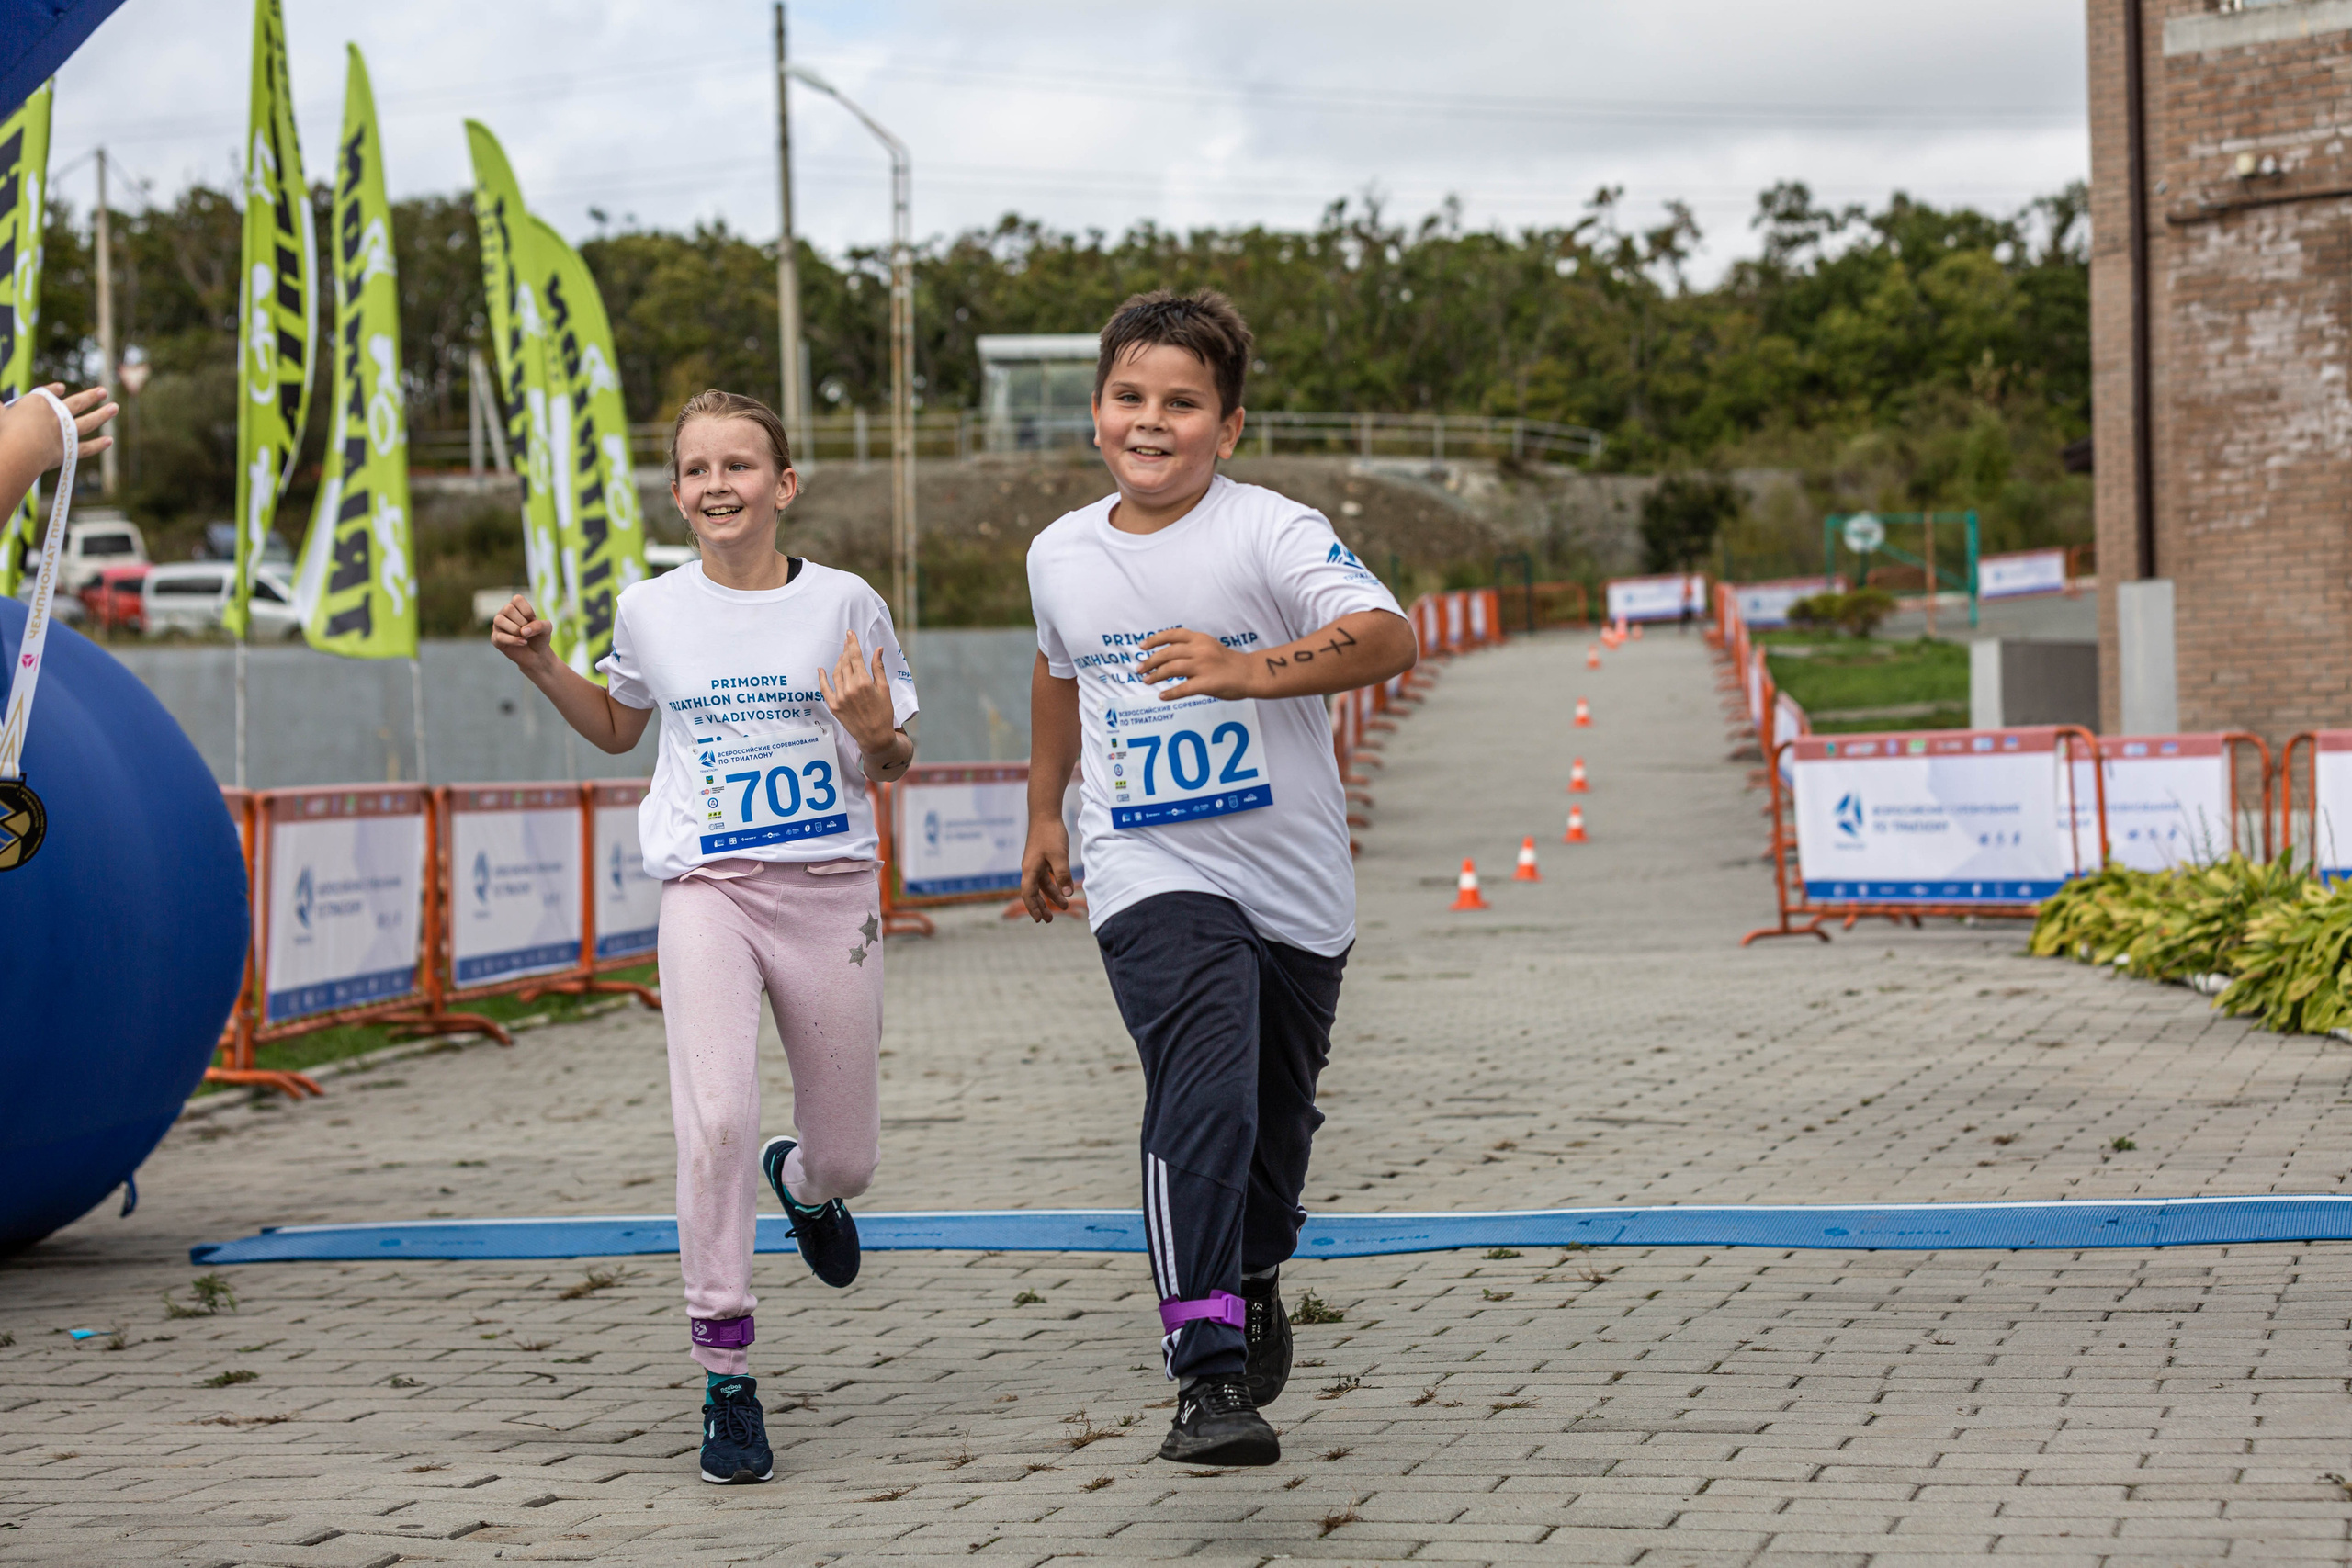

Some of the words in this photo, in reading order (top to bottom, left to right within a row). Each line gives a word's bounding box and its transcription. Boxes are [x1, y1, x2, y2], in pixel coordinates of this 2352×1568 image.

[28, 542, 57, 640] ЧЕМПИОНАТ
[51, 417, 73, 538] ПРИМОРСКОГО
[1102, 624, 1184, 647] PRIMO
[711, 675, 787, 690] PRIMORYE
[669, 694, 731, 712] TRIATHLON
[736, 691, 826, 704] CHAMPIONS
[1118, 705, 1170, 717] ВСЕРОССИЙСКИЕ
[1172, 697, 1224, 710] СОРЕВНОВА
[705, 708, 800, 724] VLADIVOSTOK
[1131, 713, 1175, 726] ТРИАТЛОНУ
[717, 744, 771, 758] ВСЕРОССИЙСКИЕ
[771, 737, 819, 750] СОРЕВНОВАНИЯ
[718, 756, 729, 765] ПО
[730, 751, 774, 763] ТРИАТЛОНУ
[1126, 721, 1259, 796] 702
[725, 759, 837, 823] 703
